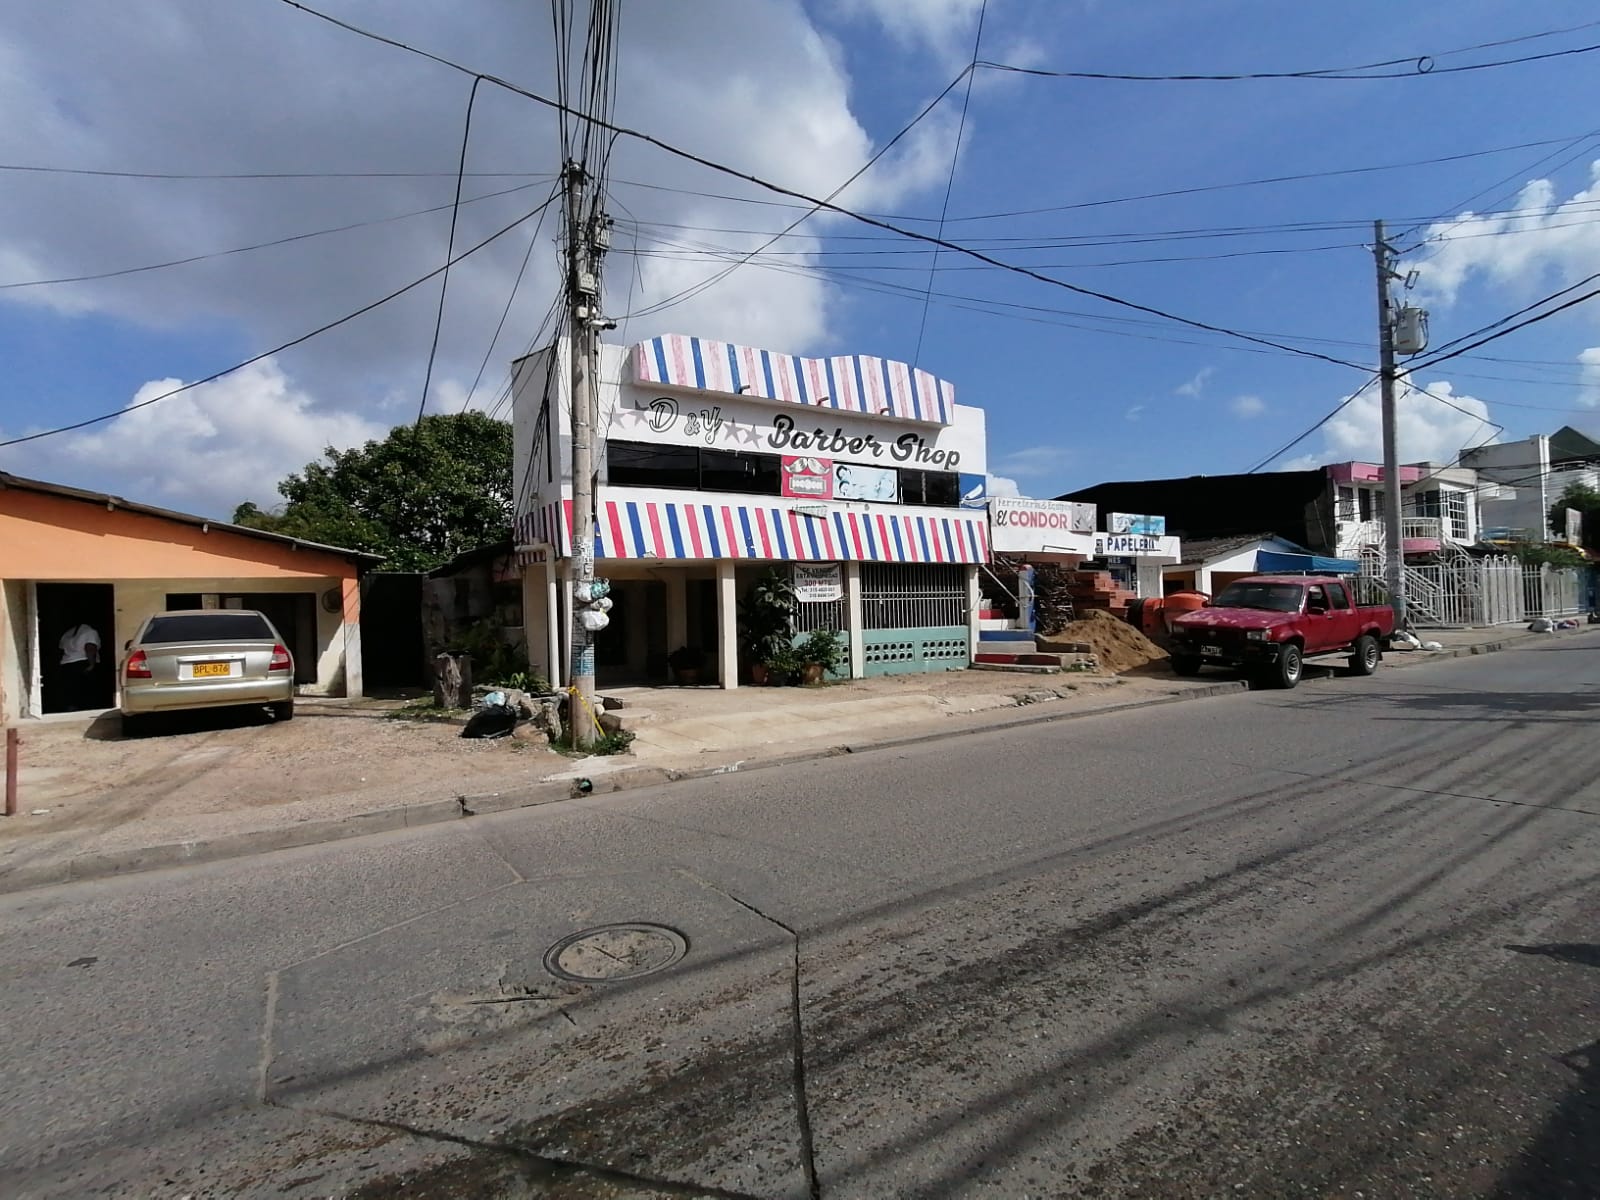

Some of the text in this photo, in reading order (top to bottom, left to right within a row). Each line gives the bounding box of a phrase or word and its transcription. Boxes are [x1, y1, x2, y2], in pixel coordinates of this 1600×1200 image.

[767, 413, 884, 457] Barber
[889, 433, 961, 471] Shop
[1009, 510, 1068, 529] CONDOR
